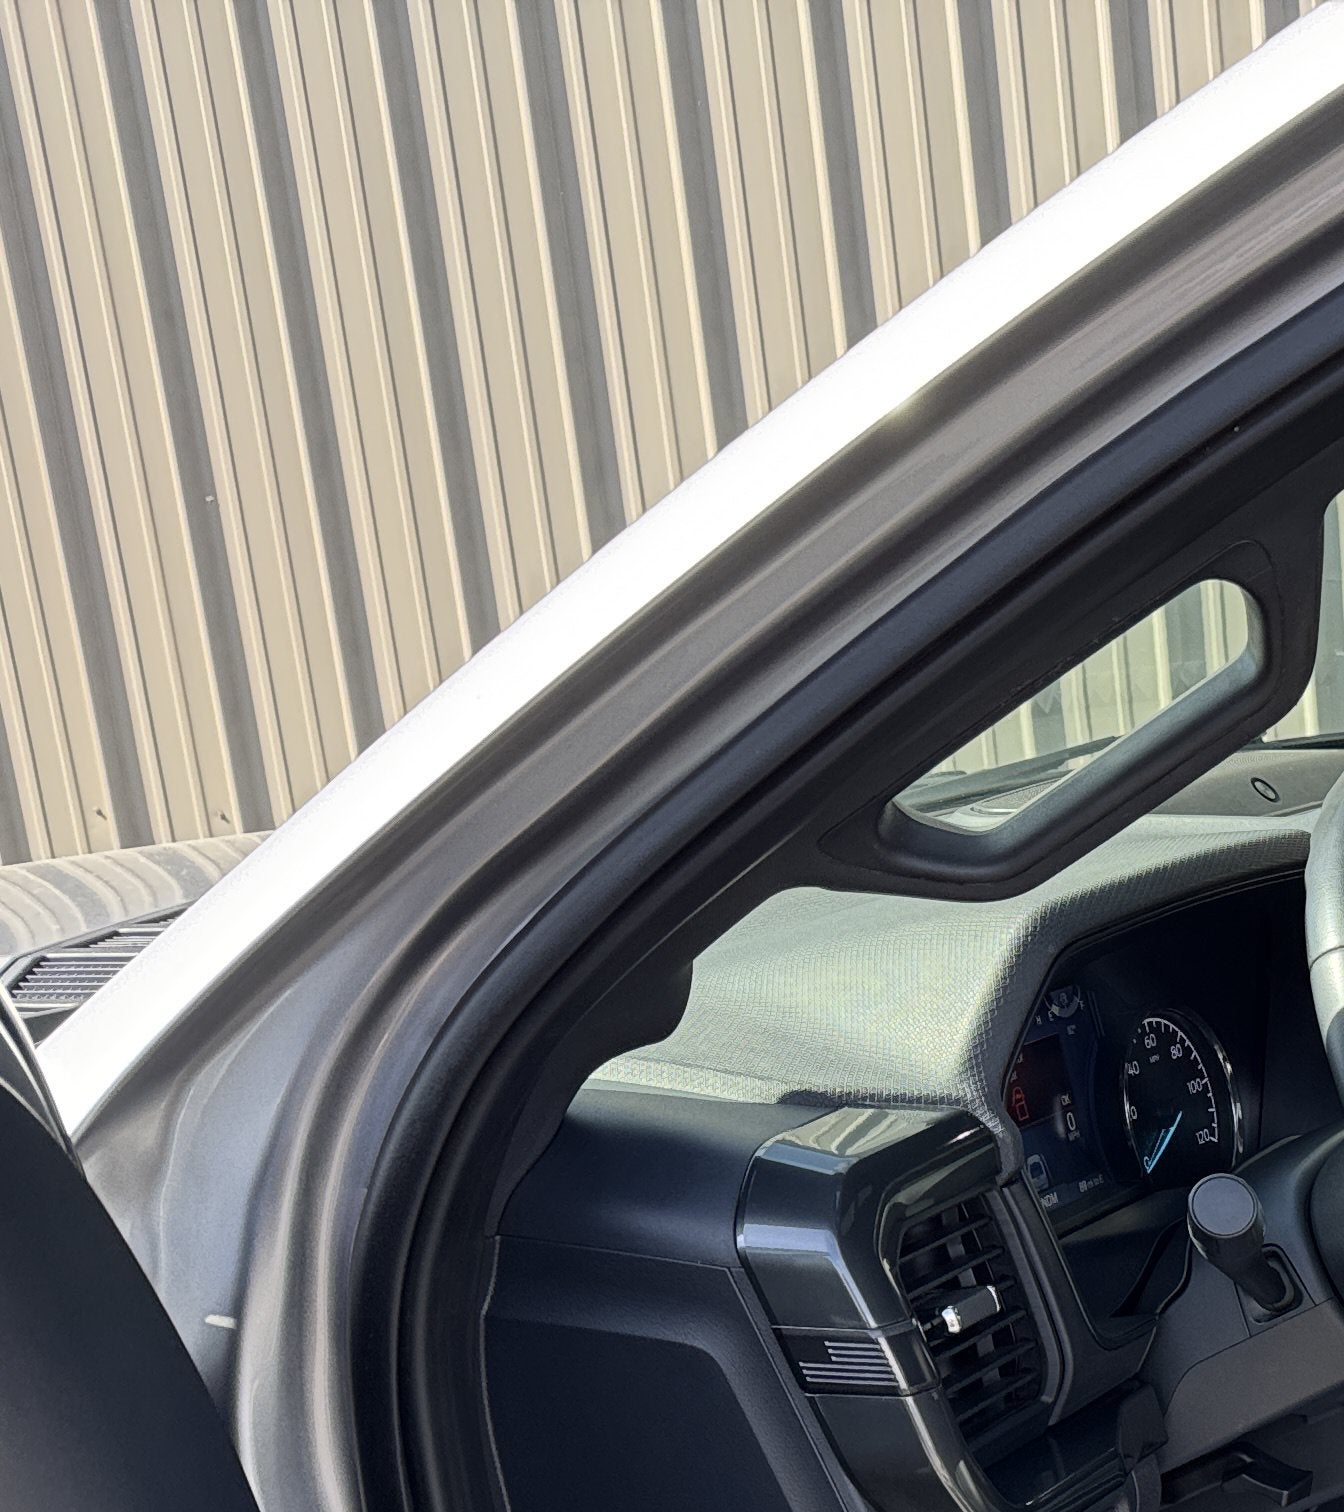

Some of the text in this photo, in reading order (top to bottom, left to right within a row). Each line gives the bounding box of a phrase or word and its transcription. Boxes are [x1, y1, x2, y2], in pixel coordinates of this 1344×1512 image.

[1144, 1033, 1157, 1049] 60
[1170, 1044, 1183, 1060] 80
[1127, 1060, 1140, 1077] 40
[1186, 1078, 1203, 1095] 100
[1066, 1111, 1076, 1131] 0
[1195, 1128, 1211, 1145] 120
